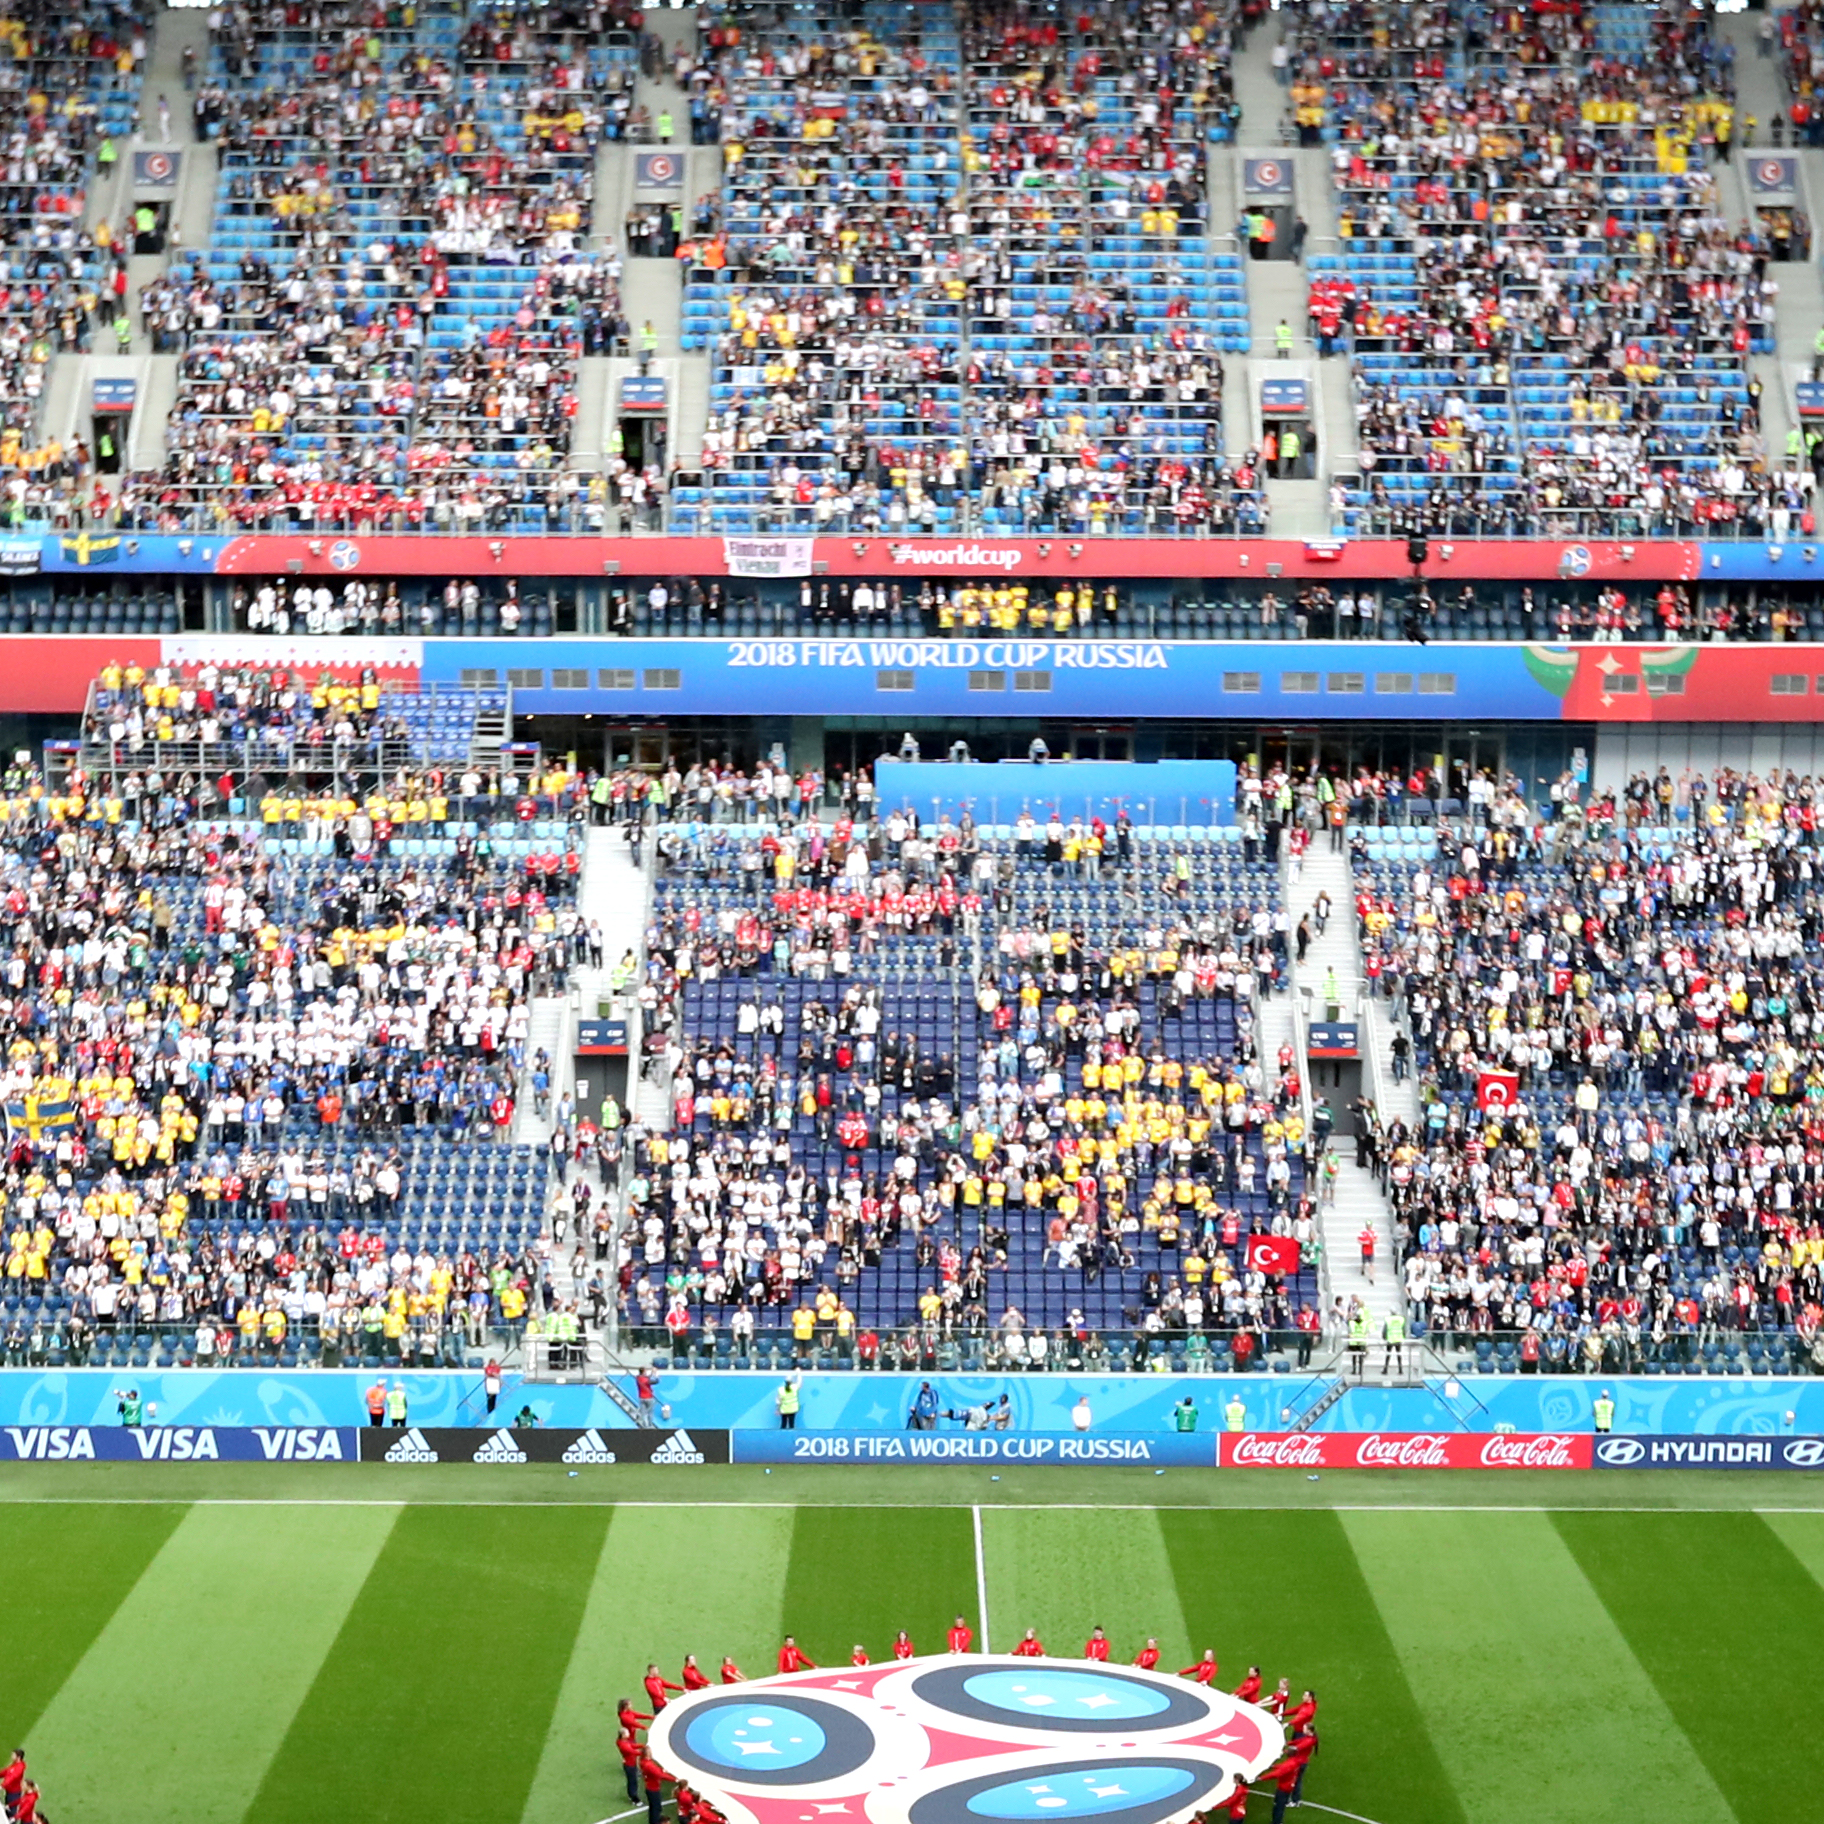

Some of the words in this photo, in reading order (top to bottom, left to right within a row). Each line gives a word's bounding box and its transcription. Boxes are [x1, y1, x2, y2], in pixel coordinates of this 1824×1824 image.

[892, 542, 1022, 571] #worldcup
[726, 641, 796, 667] 2018
[801, 641, 866, 667] FIFA
[870, 642, 980, 668] WORLD
[984, 642, 1049, 668] CUP
[1054, 643, 1169, 669] RUSSIA
[5, 1427, 96, 1459] VISA
[128, 1428, 219, 1460] VISA
[251, 1428, 343, 1460] VISA
[793, 1437, 850, 1457] 2018
[855, 1438, 905, 1457] FIFA
[909, 1438, 998, 1458] WORLD
[1002, 1438, 1055, 1458] CUP
[1059, 1438, 1151, 1459] RUSSIA
[1650, 1441, 1772, 1463] HYUNDAI
[384, 1448, 439, 1464] adidas
[472, 1448, 527, 1464] adidas
[561, 1448, 616, 1464] adidas
[650, 1448, 705, 1464] adidas
